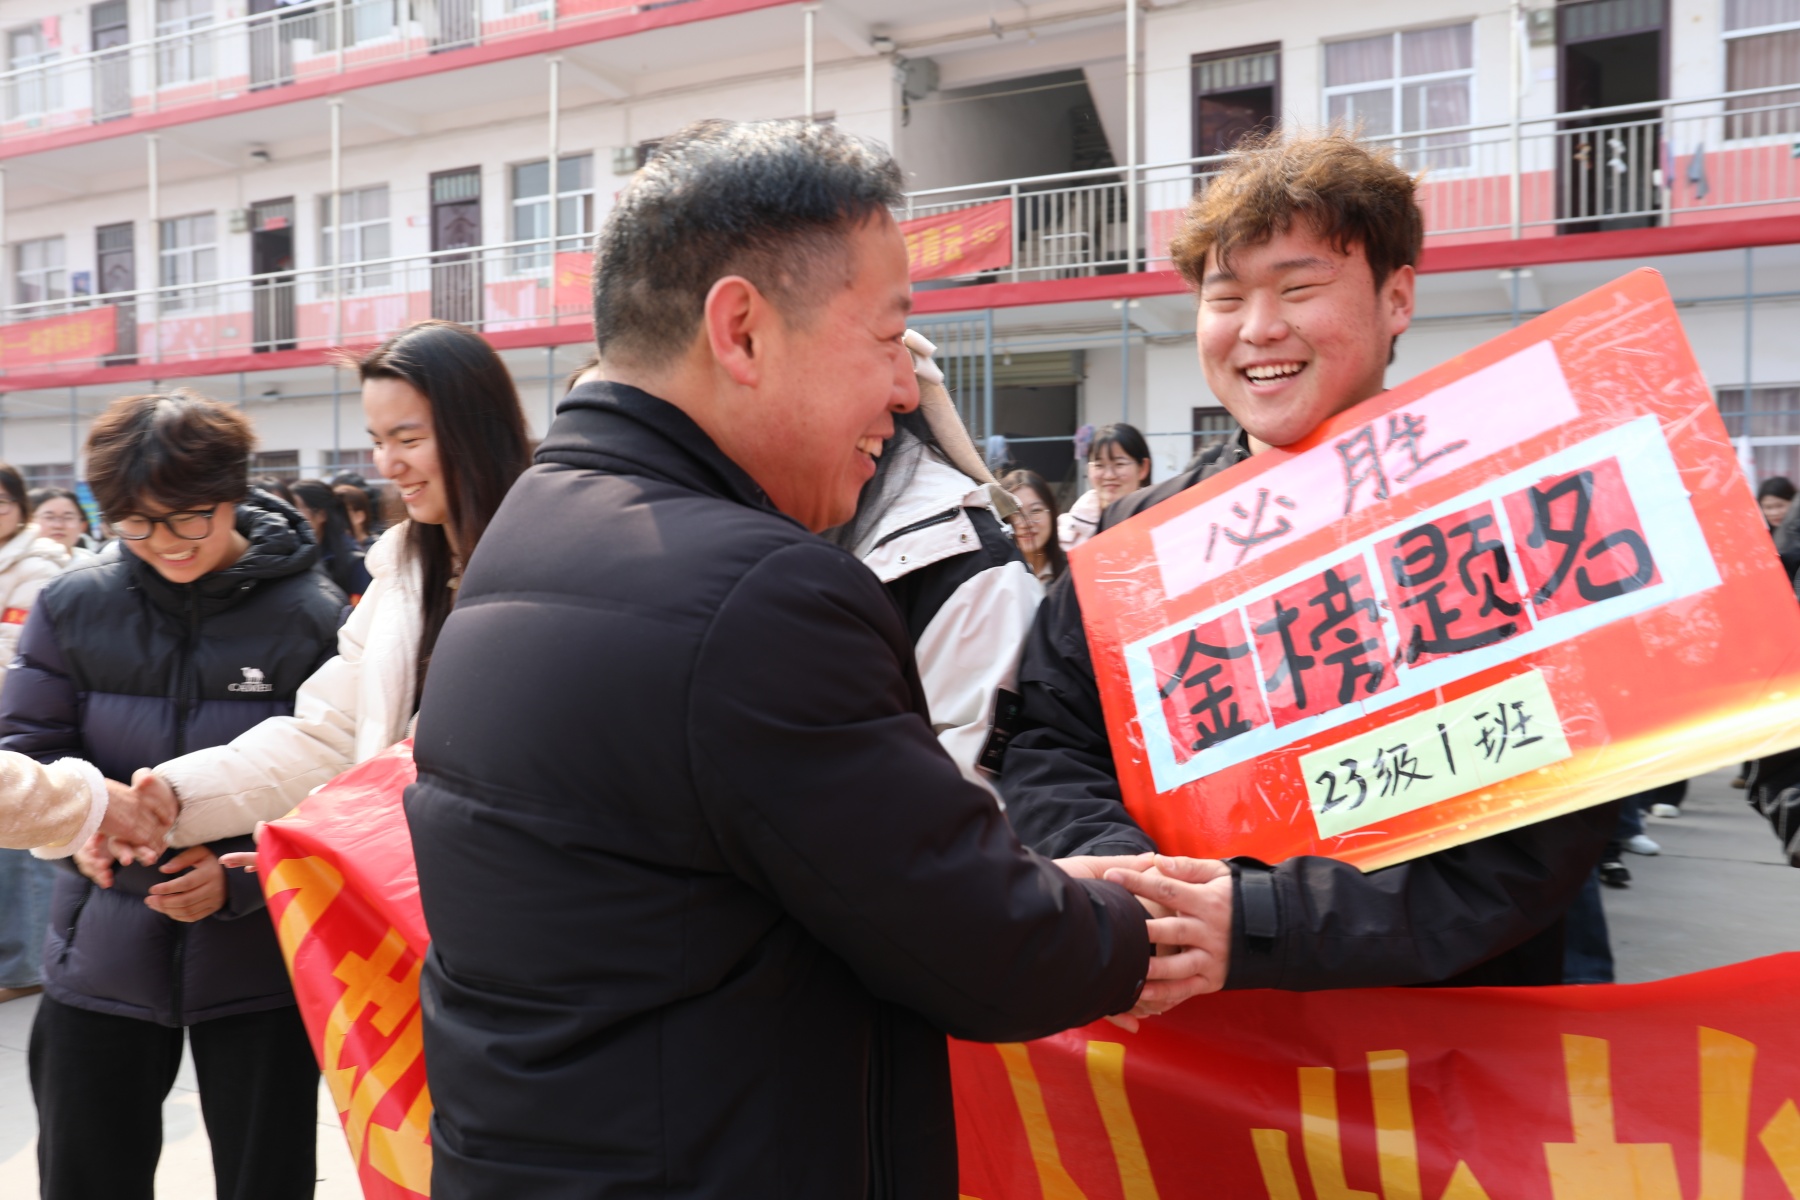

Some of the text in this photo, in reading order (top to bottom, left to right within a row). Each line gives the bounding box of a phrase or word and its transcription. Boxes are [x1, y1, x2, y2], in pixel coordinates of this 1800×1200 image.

[1204, 411, 1469, 567] 必胜
[1159, 470, 1654, 752] 金榜题名
[1315, 700, 1545, 815] 23级1班
